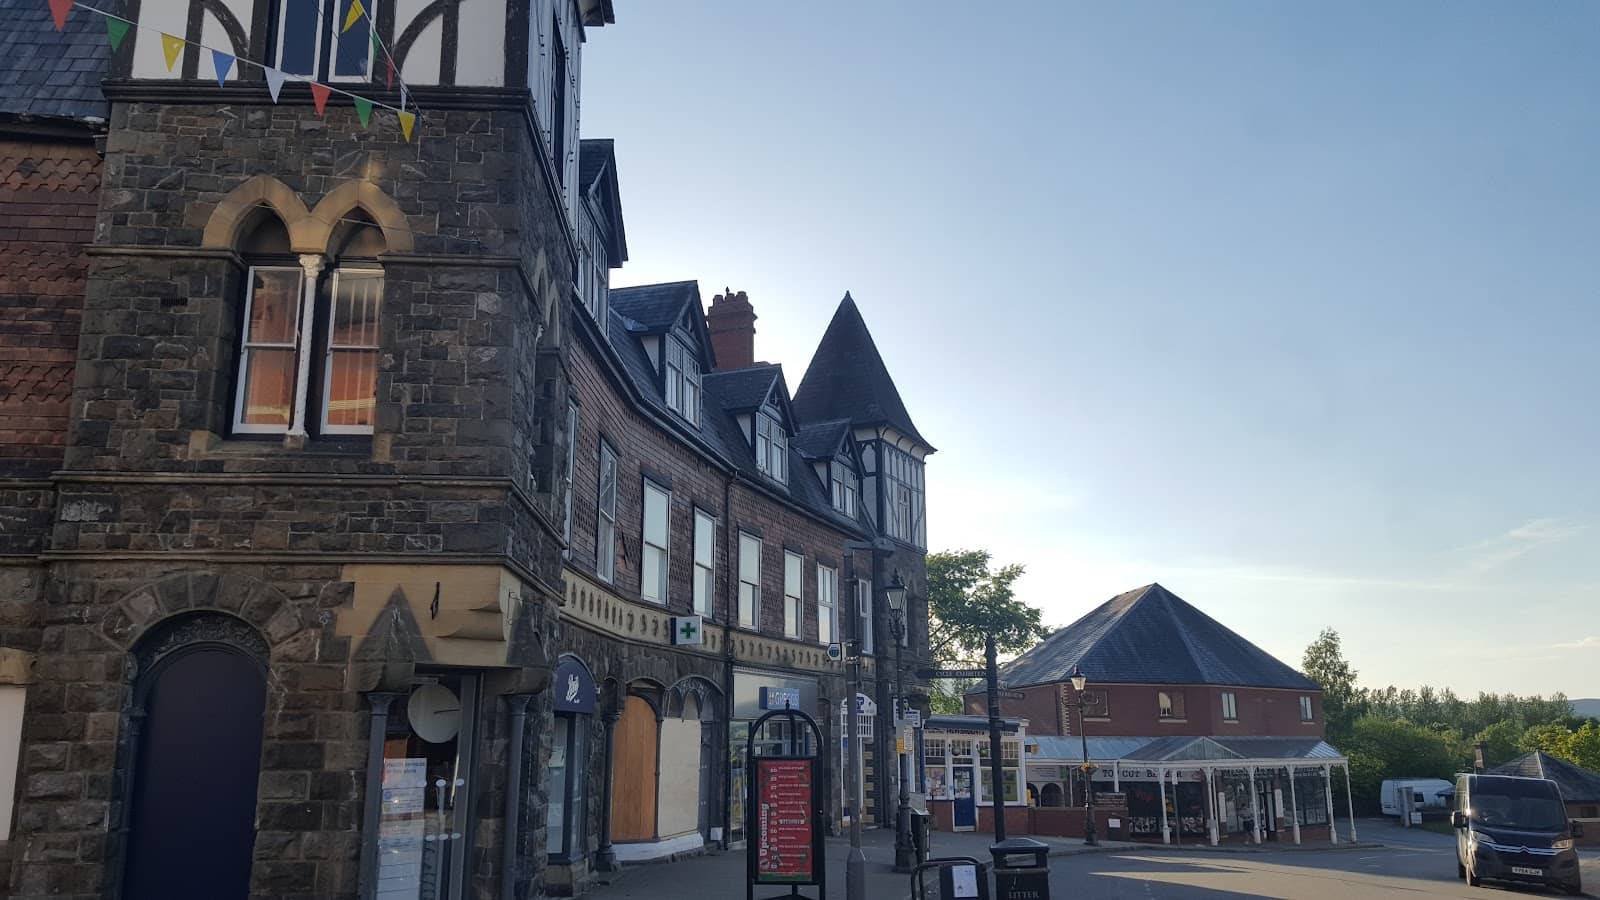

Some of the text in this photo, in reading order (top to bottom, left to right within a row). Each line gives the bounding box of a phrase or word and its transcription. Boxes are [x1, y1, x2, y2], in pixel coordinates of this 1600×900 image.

[1122, 769, 1140, 778] CUT
[760, 803, 770, 856] Upcoming
[1008, 890, 1040, 899] LITTER
